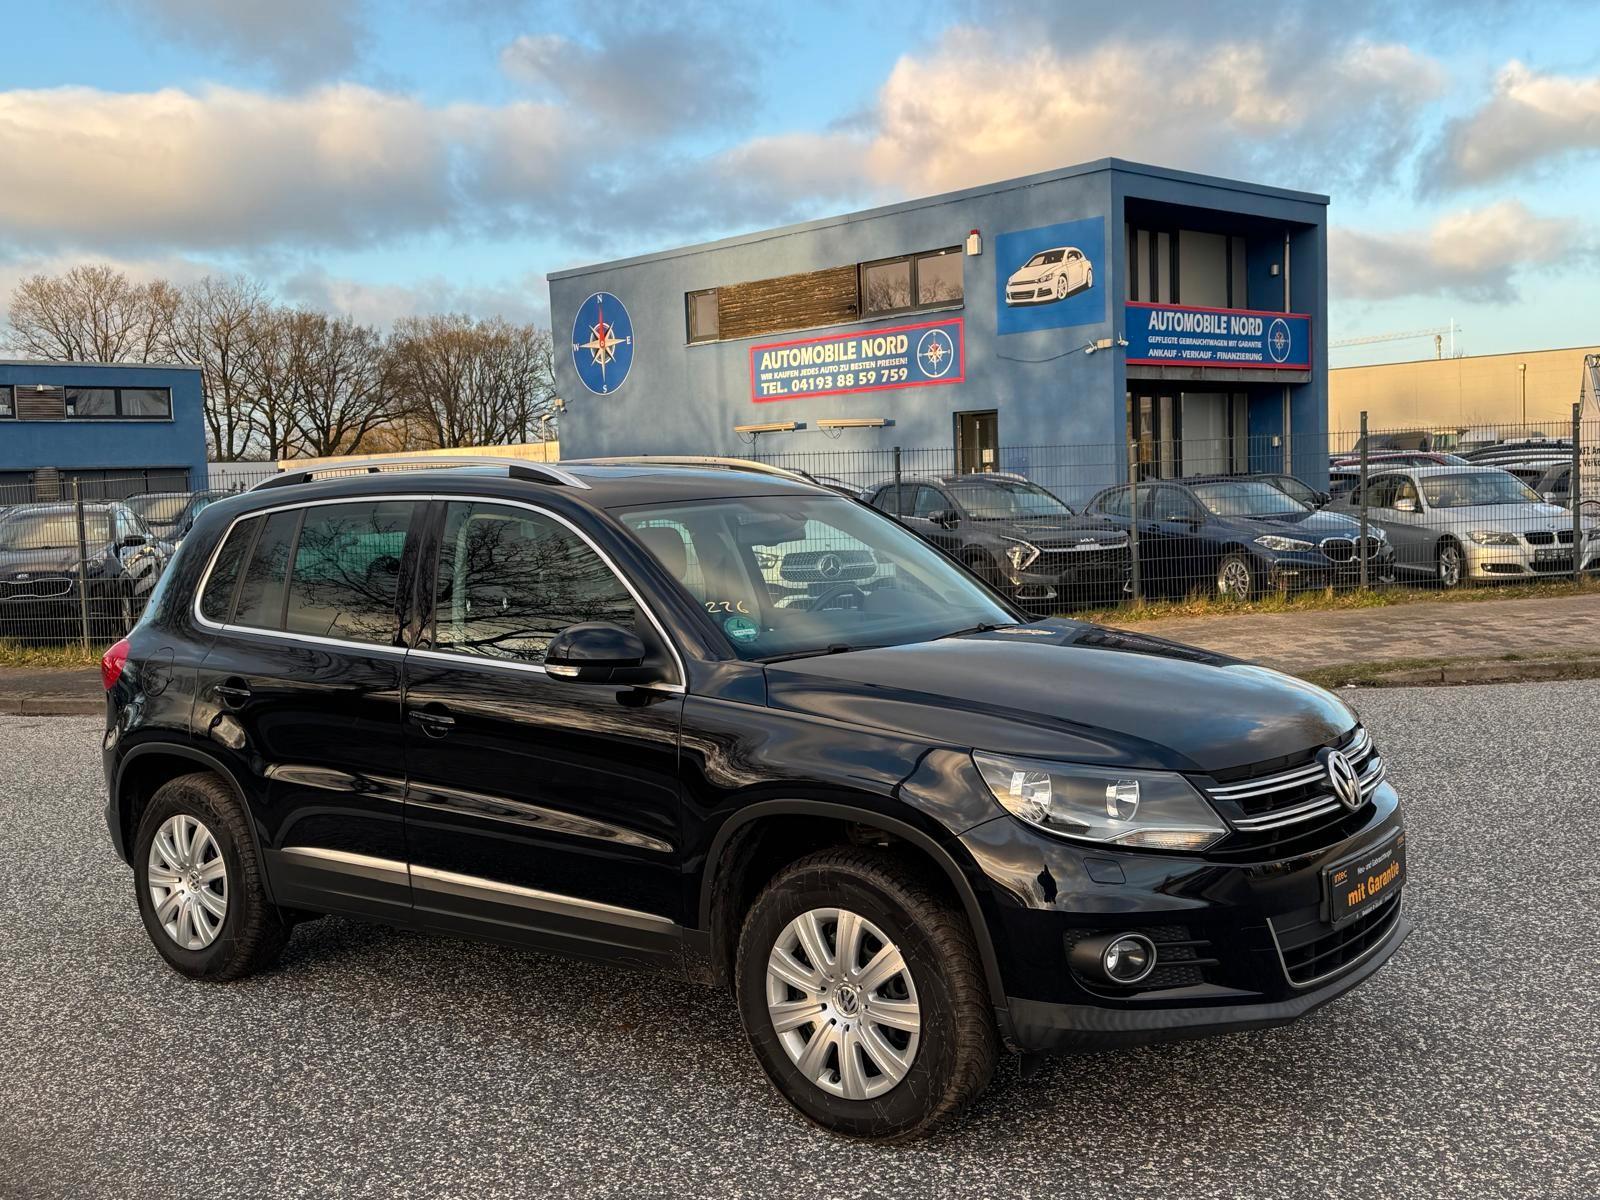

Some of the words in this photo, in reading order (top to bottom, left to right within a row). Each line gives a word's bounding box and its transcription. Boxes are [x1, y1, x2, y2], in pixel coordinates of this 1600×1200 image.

[1148, 311, 1227, 334] AUTOMOBILE
[1231, 317, 1263, 336] NORD
[761, 341, 856, 370] AUTOMOBILE
[861, 334, 909, 358] NORD
[1148, 336, 1178, 344] GEPFLEGTE
[1179, 337, 1228, 347] GEBRAUCHTWAGEN
[1228, 340, 1237, 348] MIT
[1238, 340, 1262, 348] GARANTIE
[1148, 348, 1178, 358] ANKAUF
[1182, 350, 1213, 360] VERKAUF
[1217, 351, 1263, 361] FINANZIERUNG
[761, 373, 773, 381] WIR
[774, 370, 799, 379] KAUFEN
[800, 367, 820, 377] JEDES
[820, 365, 838, 374] AUTO
[839, 363, 849, 372] ZU
[850, 361, 876, 370] BESTEN
[877, 357, 908, 367] PREISEN!
[761, 382, 788, 395] TEL.
[791, 376, 833, 392] 04193
[836, 373, 854, 387] 88
[858, 371, 876, 385] 59
[881, 368, 908, 383] 759
[1348, 883, 1366, 907] mit
[1368, 860, 1400, 896] Garantie
